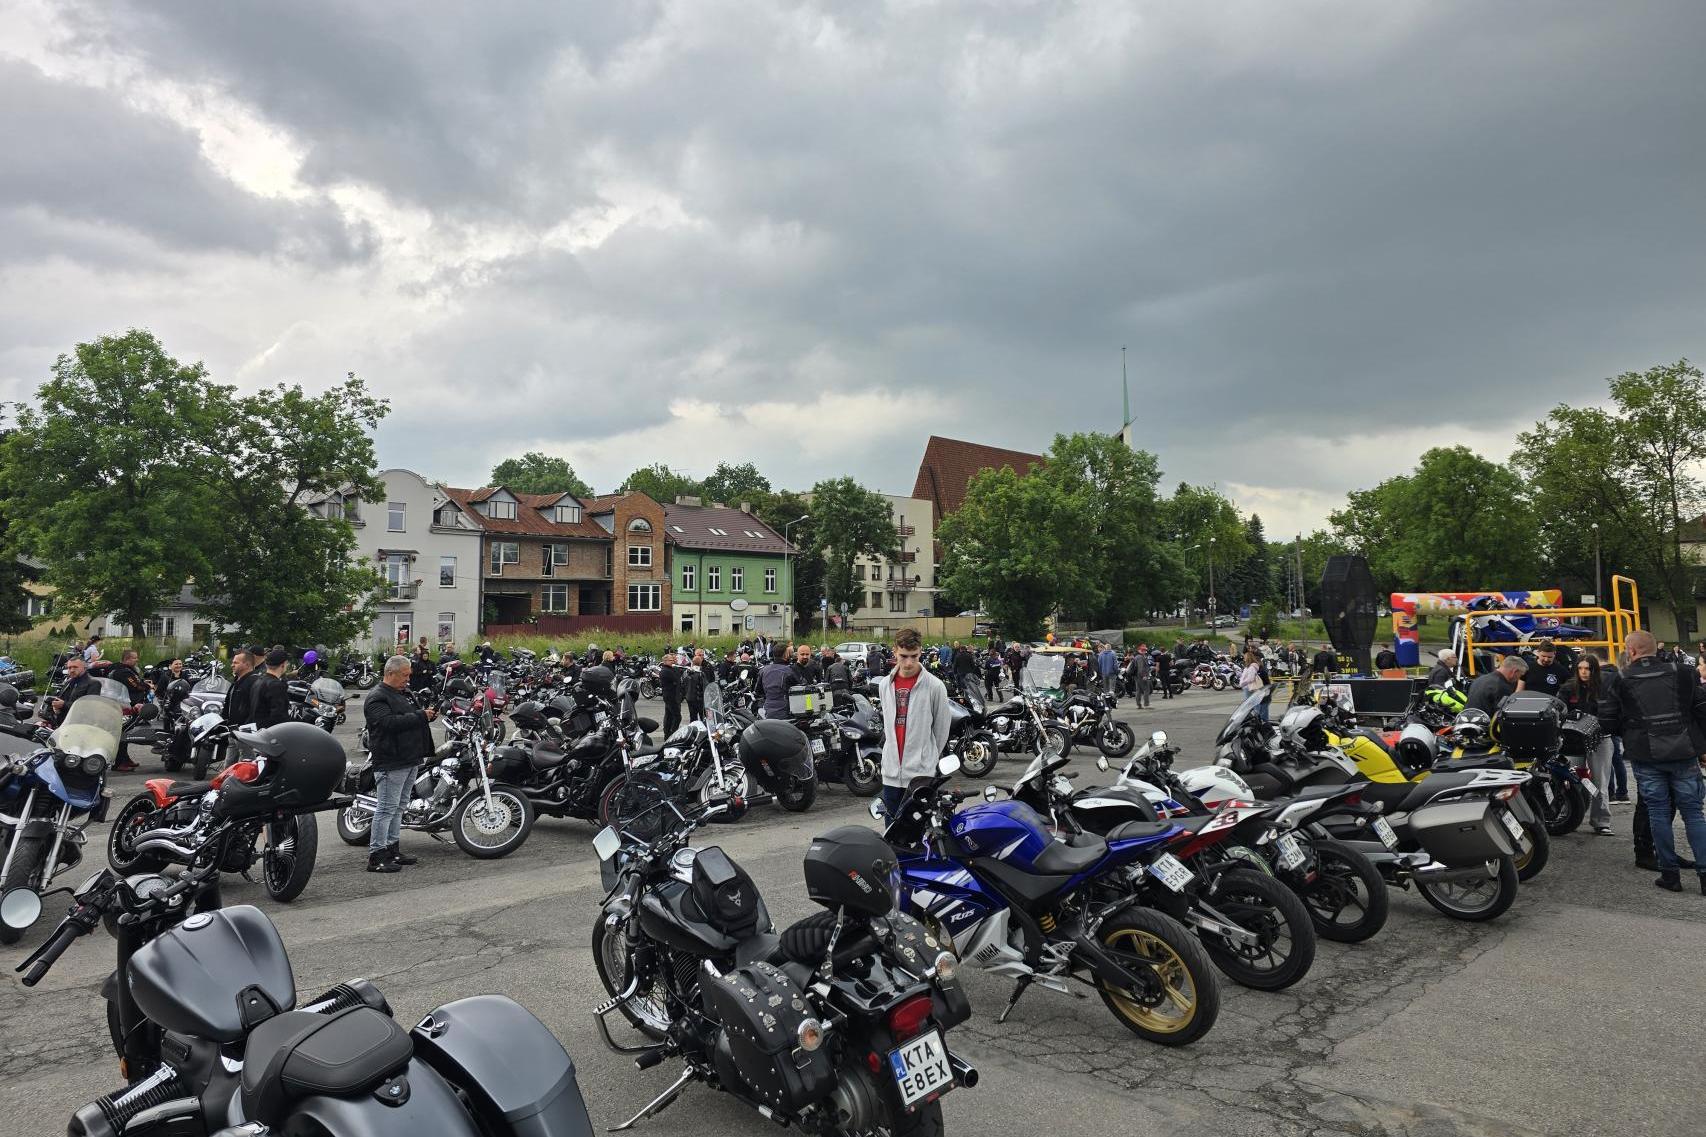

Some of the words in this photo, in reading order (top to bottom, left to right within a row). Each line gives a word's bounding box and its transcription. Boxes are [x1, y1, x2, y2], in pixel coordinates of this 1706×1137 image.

[1157, 859, 1175, 875] KTA
[1165, 867, 1189, 887] E9GR
[903, 1041, 934, 1070] KTA
[895, 1067, 906, 1078] PL
[902, 1060, 948, 1098] E8EX
